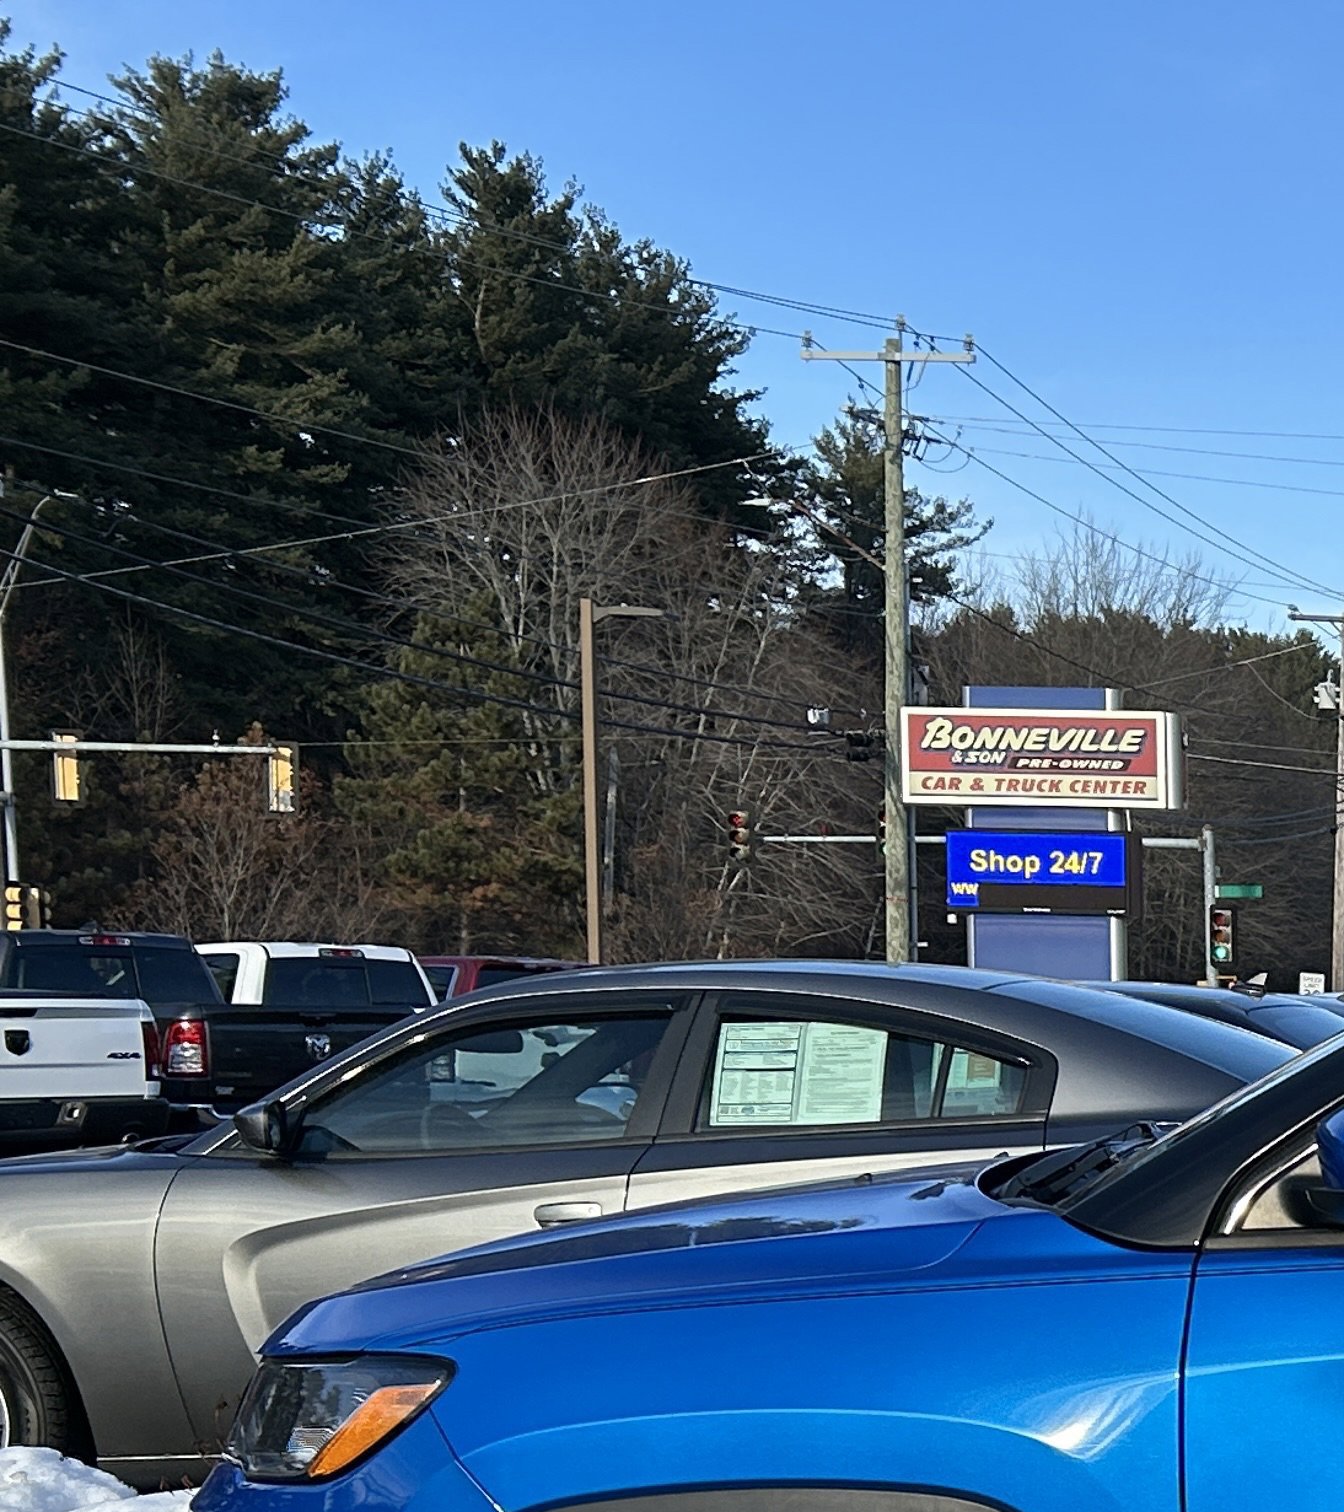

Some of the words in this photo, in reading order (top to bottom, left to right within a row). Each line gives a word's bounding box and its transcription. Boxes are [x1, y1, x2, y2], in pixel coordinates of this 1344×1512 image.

[920, 716, 1146, 753] BONNEVILLE
[964, 751, 1006, 764] SON
[1016, 758, 1125, 771] PRE-OWNED
[921, 776, 961, 791] CAR
[969, 777, 985, 791] &
[994, 778, 1064, 793] TRUCK
[1069, 779, 1147, 794] CENTER
[969, 849, 1041, 878] Shop
[1049, 851, 1103, 875] 24/7
